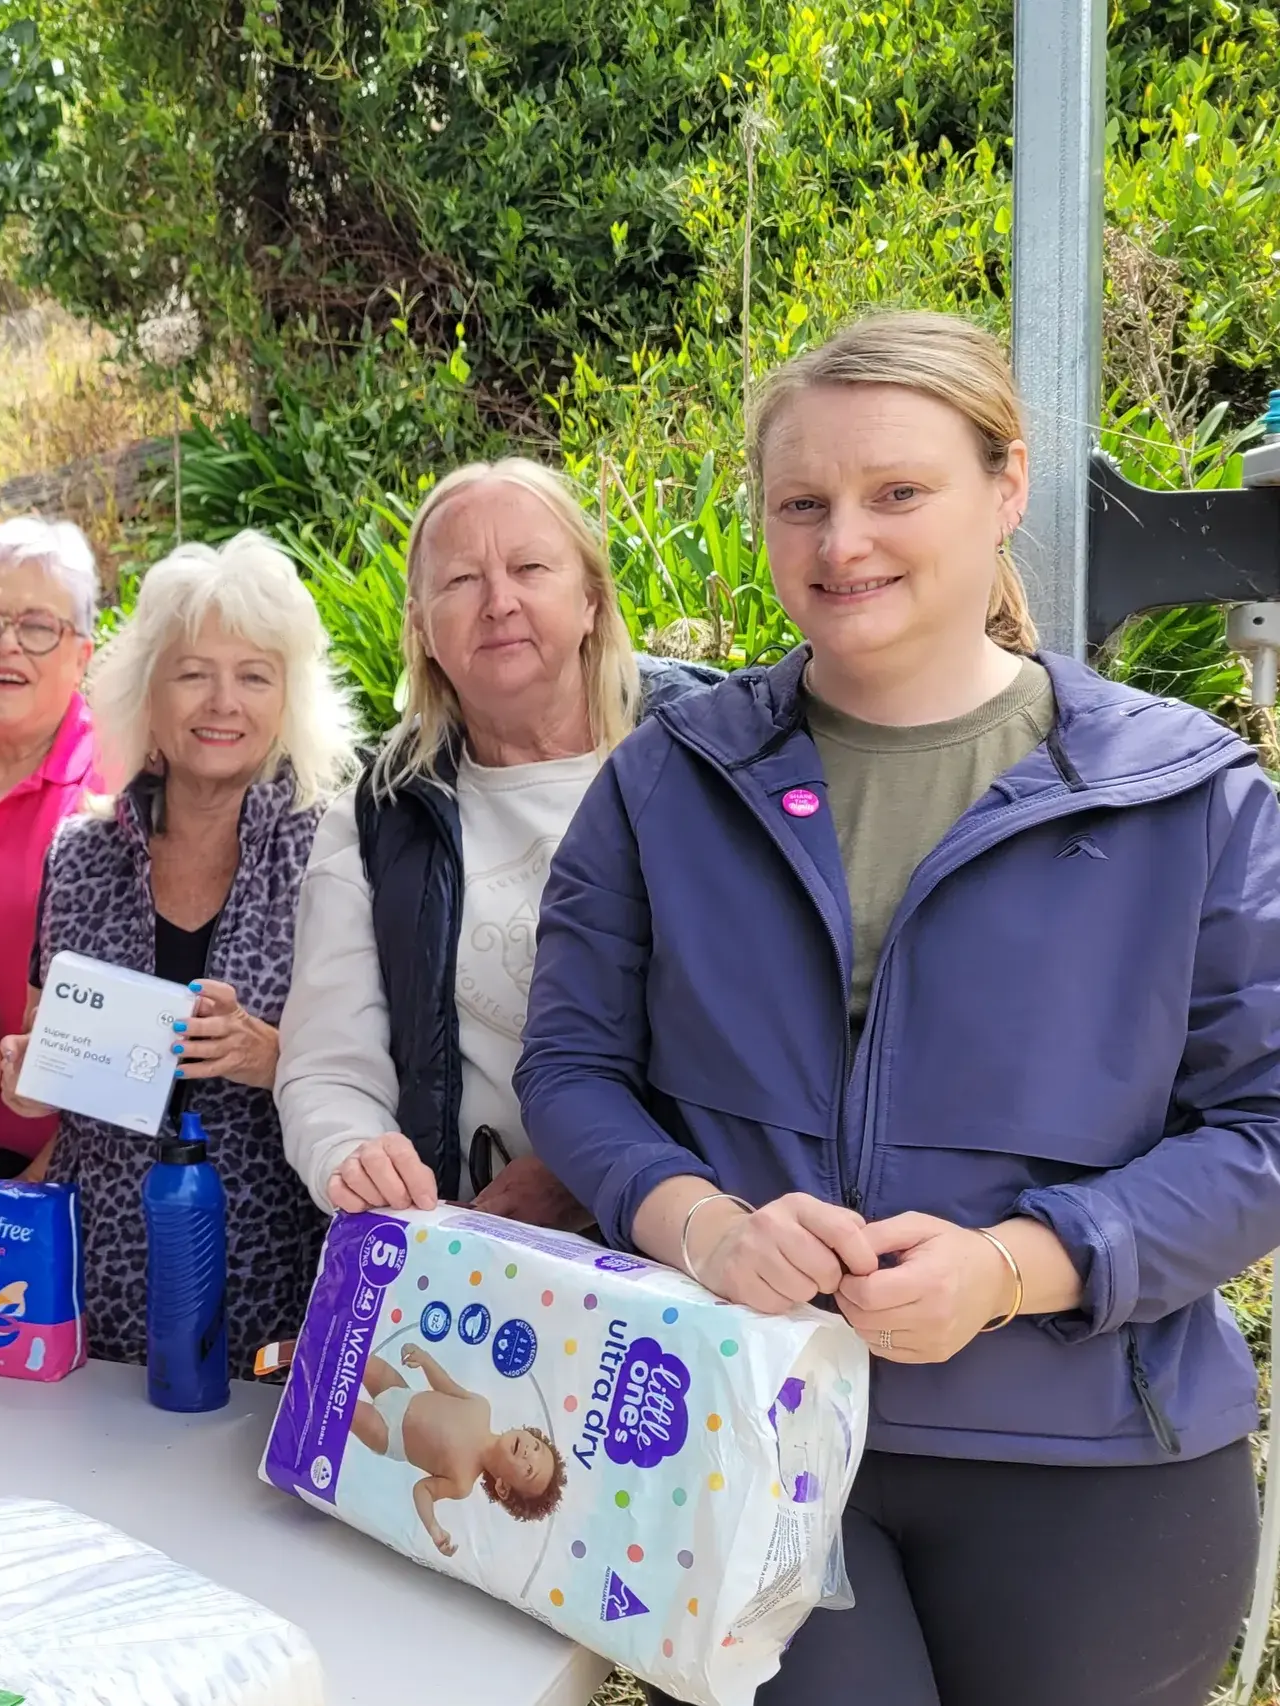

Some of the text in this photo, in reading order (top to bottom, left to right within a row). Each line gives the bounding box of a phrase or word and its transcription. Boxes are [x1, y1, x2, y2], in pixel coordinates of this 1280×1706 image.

[55, 982, 105, 1010] CUB
[43, 1026, 93, 1047] super soft
[40, 1037, 112, 1065] nursing pads
[370, 1240, 399, 1269] 5
[394, 1248, 407, 1271] SIZE
[360, 1287, 375, 1311] 44
[341, 1320, 353, 1342] ULTRA
[338, 1342, 348, 1356] DRY
[332, 1326, 370, 1420] Walker
[572, 1319, 628, 1470] ultra dry
[614, 1360, 650, 1443] one's
[637, 1362, 682, 1451] little
[601, 1566, 611, 1603] AUSTRALIAN
